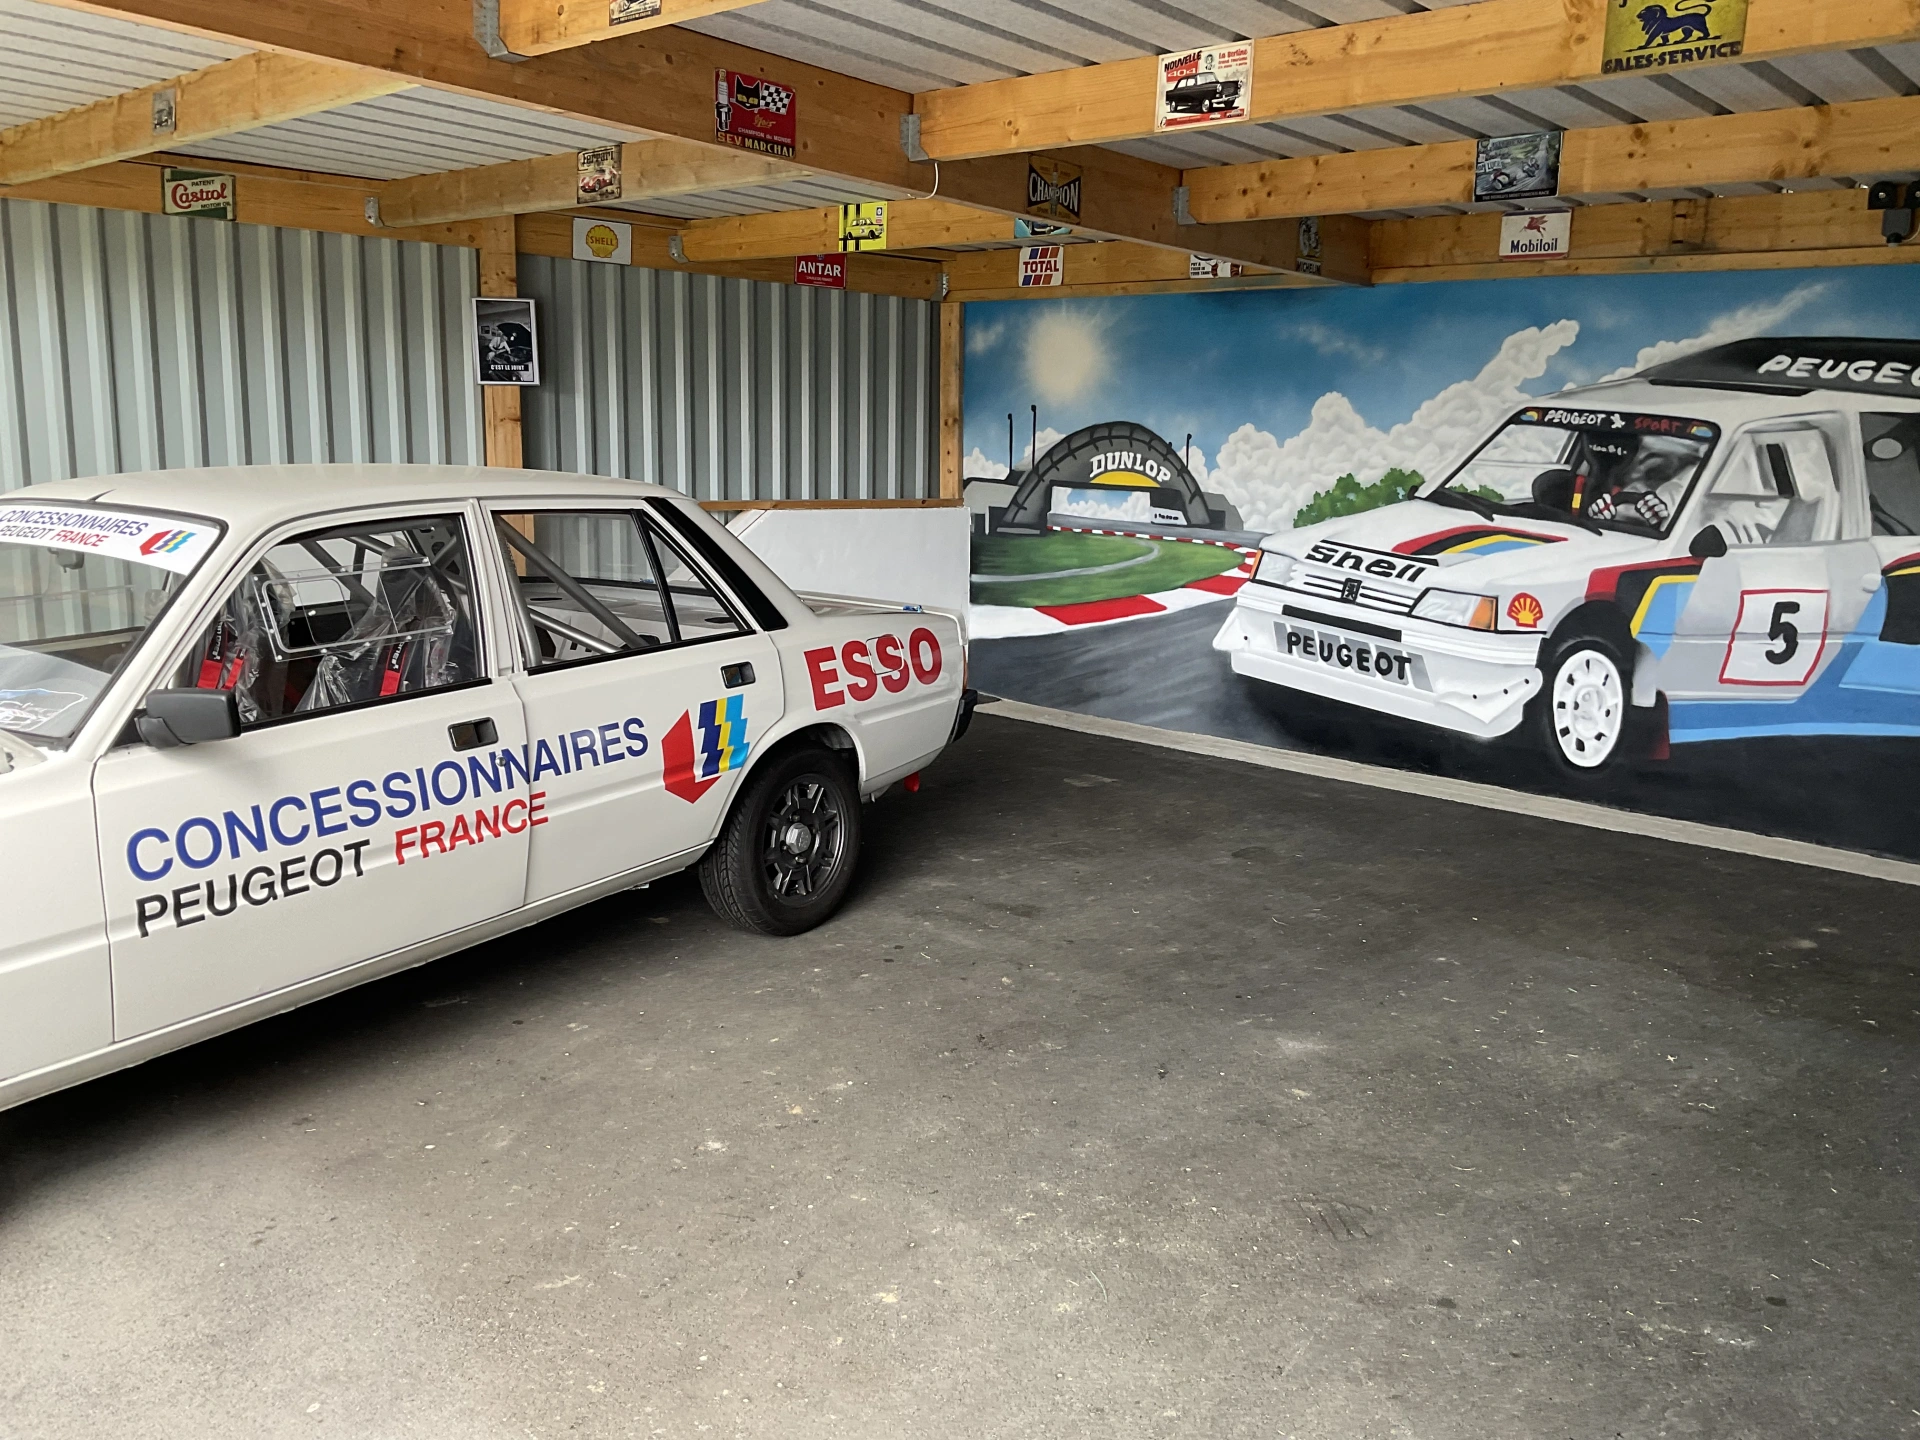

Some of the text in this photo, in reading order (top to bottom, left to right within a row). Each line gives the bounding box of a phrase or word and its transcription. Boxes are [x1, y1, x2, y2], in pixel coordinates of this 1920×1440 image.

[1164, 50, 1203, 72] NOUVELLE
[1603, 41, 1742, 74] SALES-SERVICE
[1167, 67, 1196, 77] 404
[738, 127, 765, 138] CHAMPION
[744, 137, 795, 157] MARCHAL
[171, 182, 228, 210] Castrol
[191, 179, 215, 187] PATENT
[1029, 172, 1079, 212] CHAMPION
[589, 235, 614, 246] SHELL
[1510, 238, 1558, 253] Mobiloil
[798, 260, 842, 277] ANTAR
[1023, 259, 1060, 274] TOTAL
[1757, 354, 1920, 387] PEUGE
[1544, 410, 1682, 433] PEUGEOT SPORT
[1089, 451, 1172, 482] DUNLOP
[0, 510, 149, 537] CONCESSIONNAIRES
[0, 525, 110, 548] PEUGEOT FRANCE
[1304, 544, 1427, 583] Shell
[1765, 601, 1800, 665] 5
[1286, 631, 1412, 680] PEUGEOT
[803, 627, 943, 712] ESSO
[126, 717, 649, 882] CONCESSIONNAIRES
[135, 791, 549, 939] PEUGEOT FRANCE
